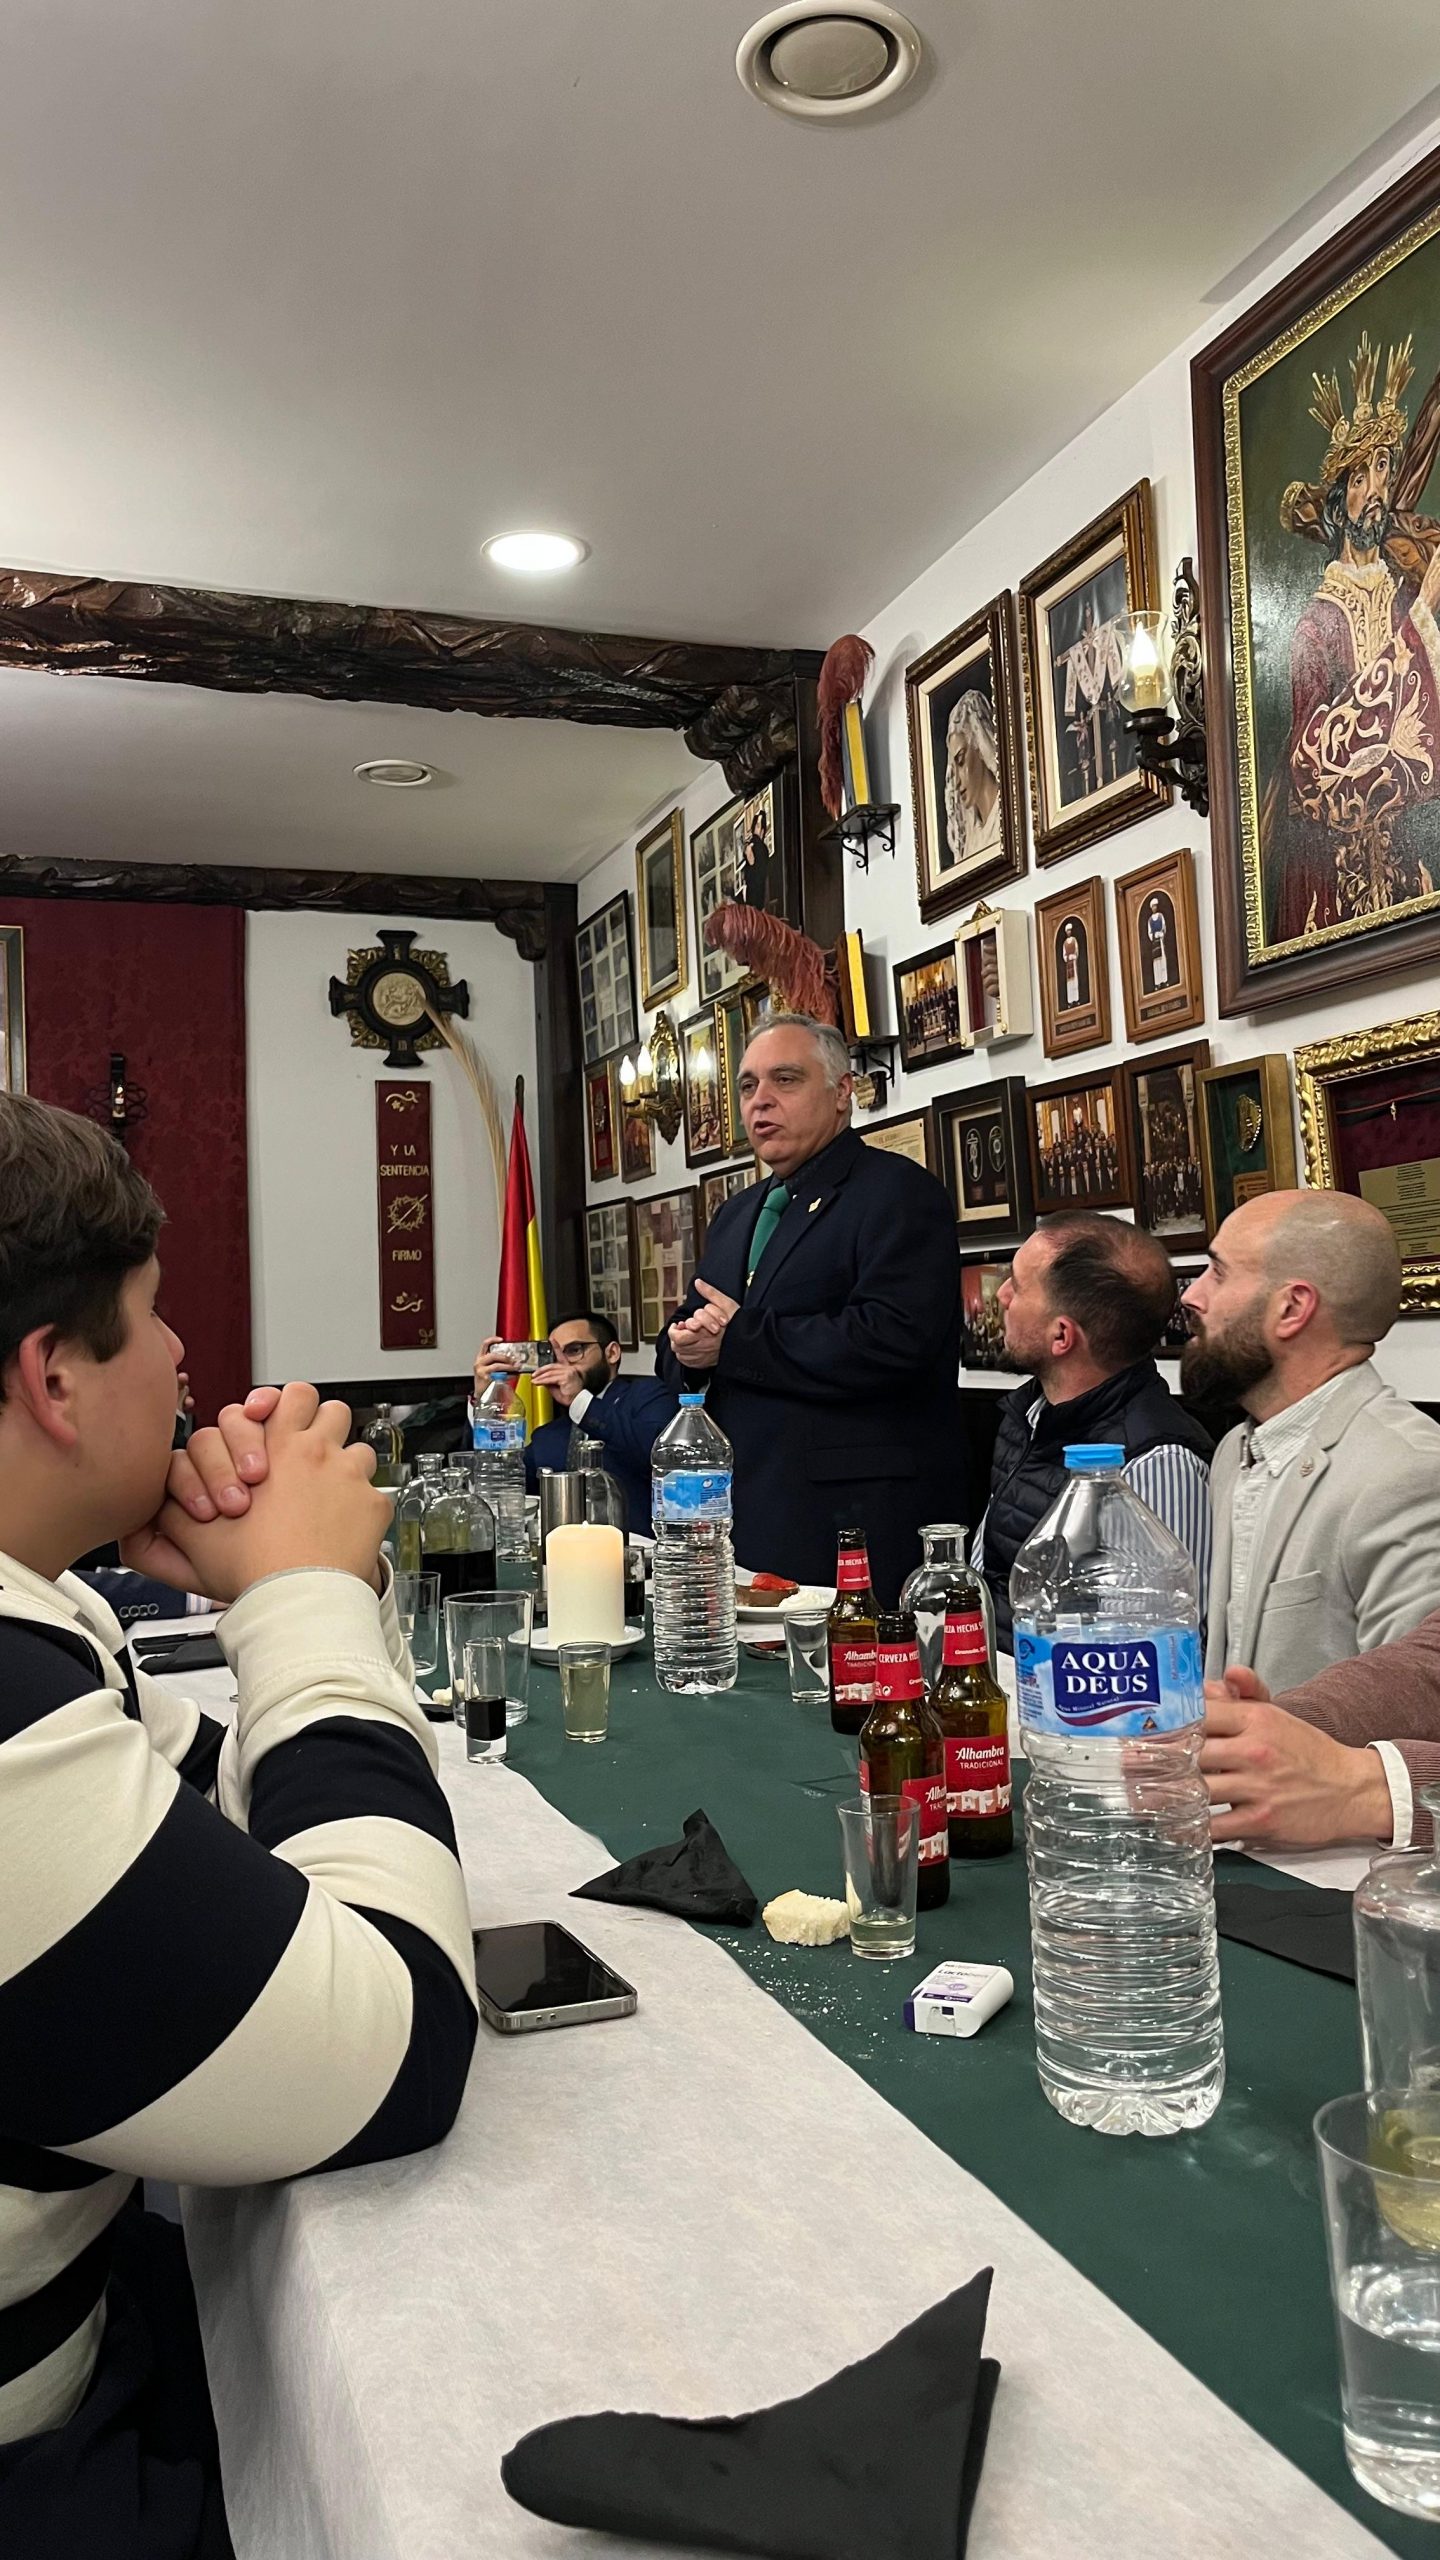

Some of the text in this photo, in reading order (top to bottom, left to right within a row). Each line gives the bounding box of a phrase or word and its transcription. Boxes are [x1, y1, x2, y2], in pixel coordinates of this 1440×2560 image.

[390, 1144, 417, 1156] Y LA
[380, 1164, 430, 1177] SENTENCIA
[392, 1249, 422, 1261] FIRMO
[956, 1622, 979, 1633] HECHA
[878, 1653, 909, 1663] CERVEZA
[1061, 1650, 1151, 1674] AQUA
[1066, 1674, 1148, 1694] DEUS
[955, 1745, 1005, 1761] Alhambra
[960, 1760, 1004, 1769] TRADICIONAL
